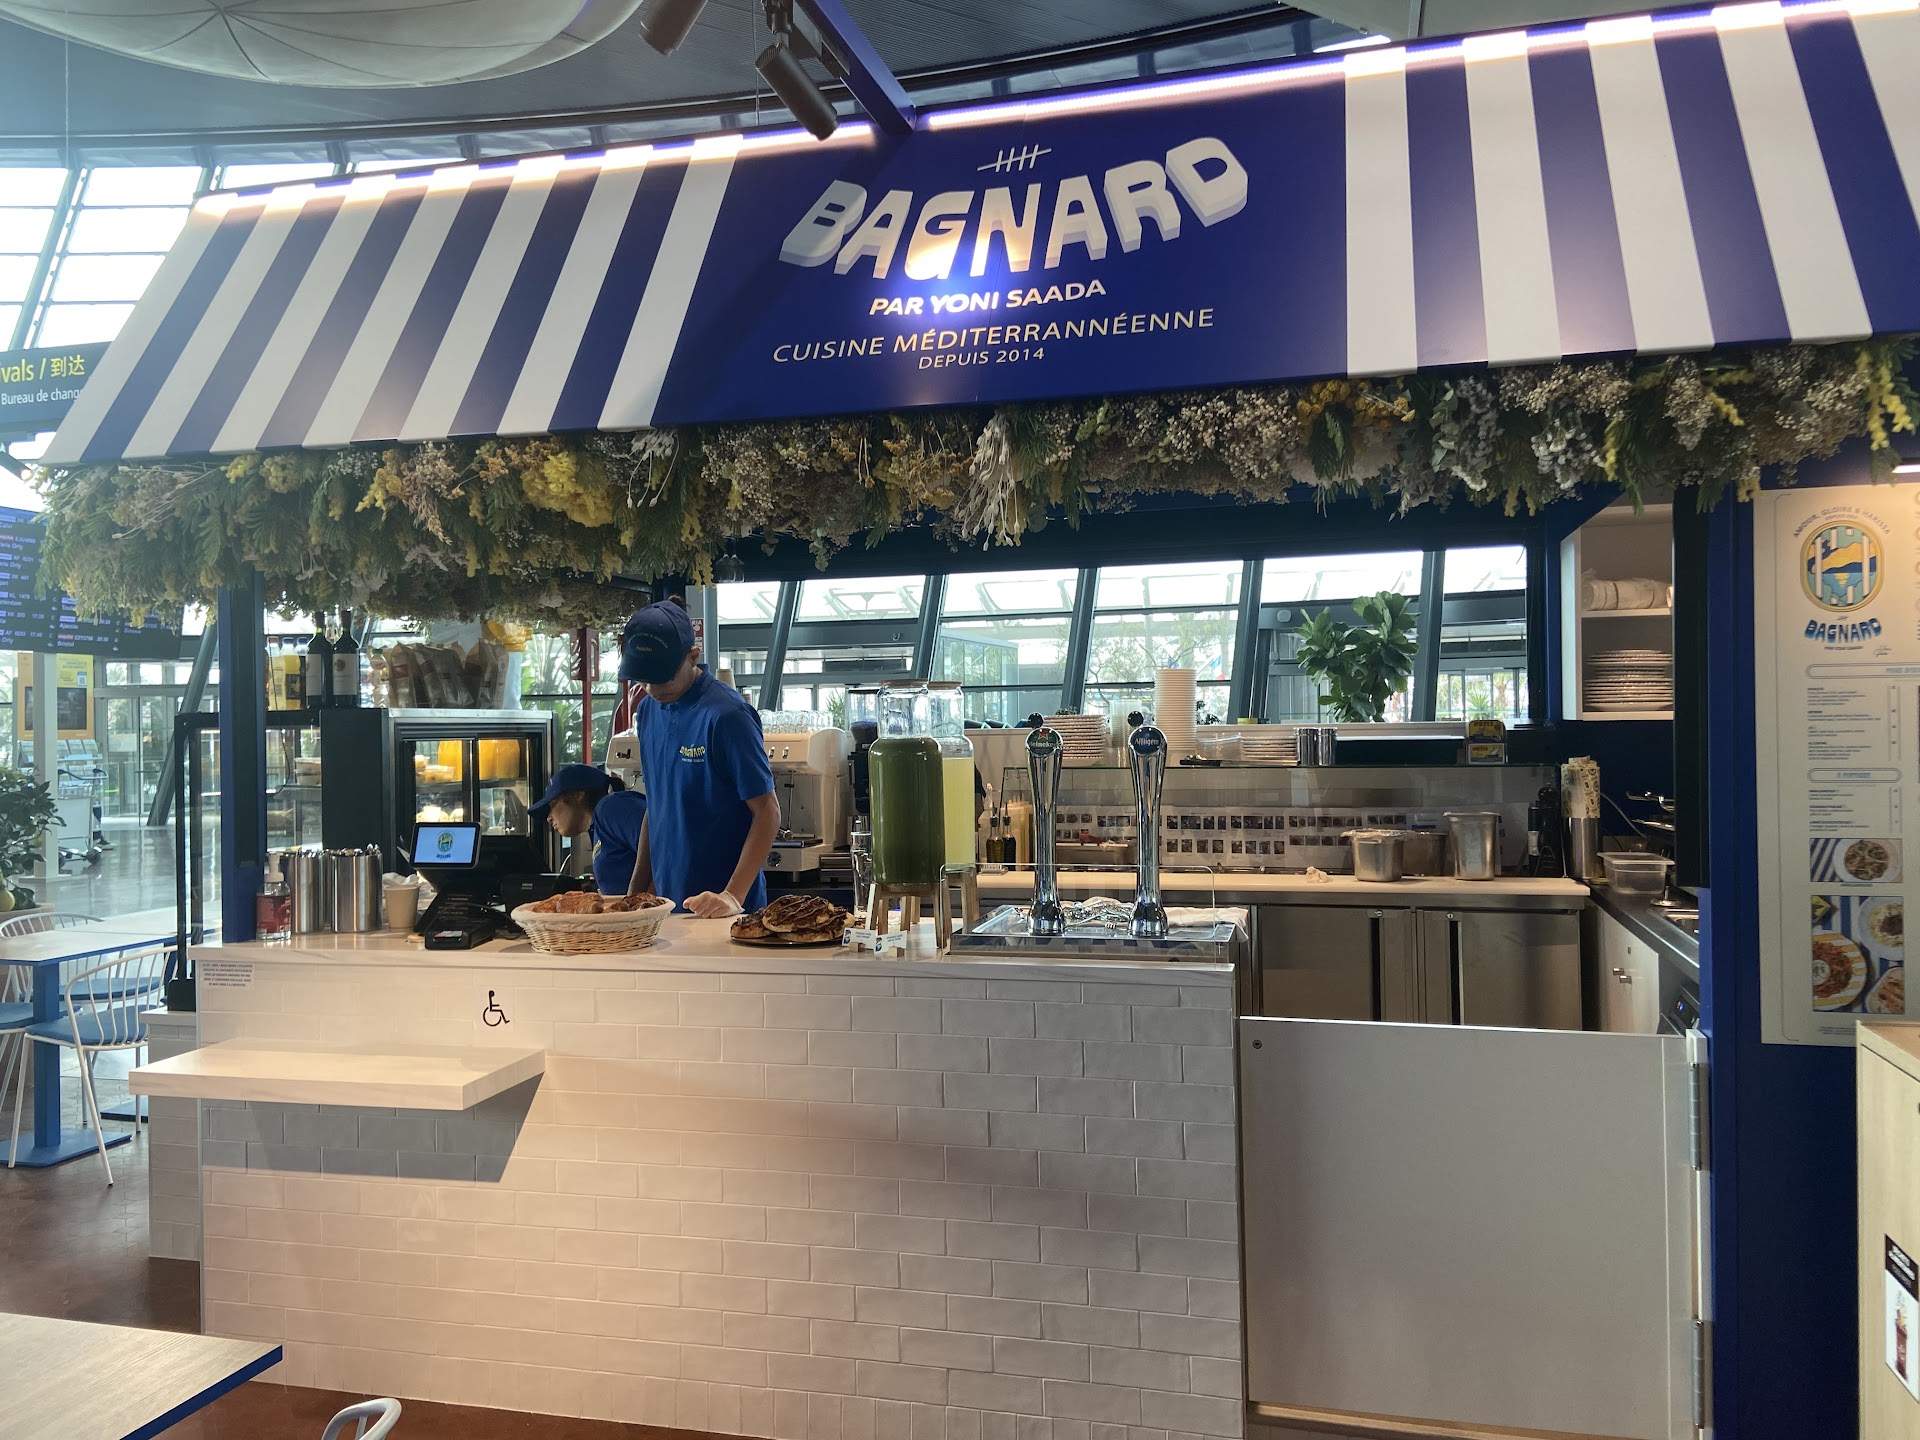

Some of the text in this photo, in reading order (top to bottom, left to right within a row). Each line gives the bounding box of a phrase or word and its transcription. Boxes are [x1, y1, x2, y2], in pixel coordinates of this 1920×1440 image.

[778, 136, 1248, 280] BAGNARD
[868, 279, 1107, 316] PAR YONI SAADA
[772, 307, 1215, 364] CUISINE MÉDITERRANNÉENNE
[0, 358, 34, 384] vals
[50, 354, 86, 378] 到达
[918, 347, 1045, 370] DEPUIS 2014
[1, 393, 34, 405] Bureau
[36, 389, 48, 402] de
[1804, 617, 1883, 643] BAGNARD
